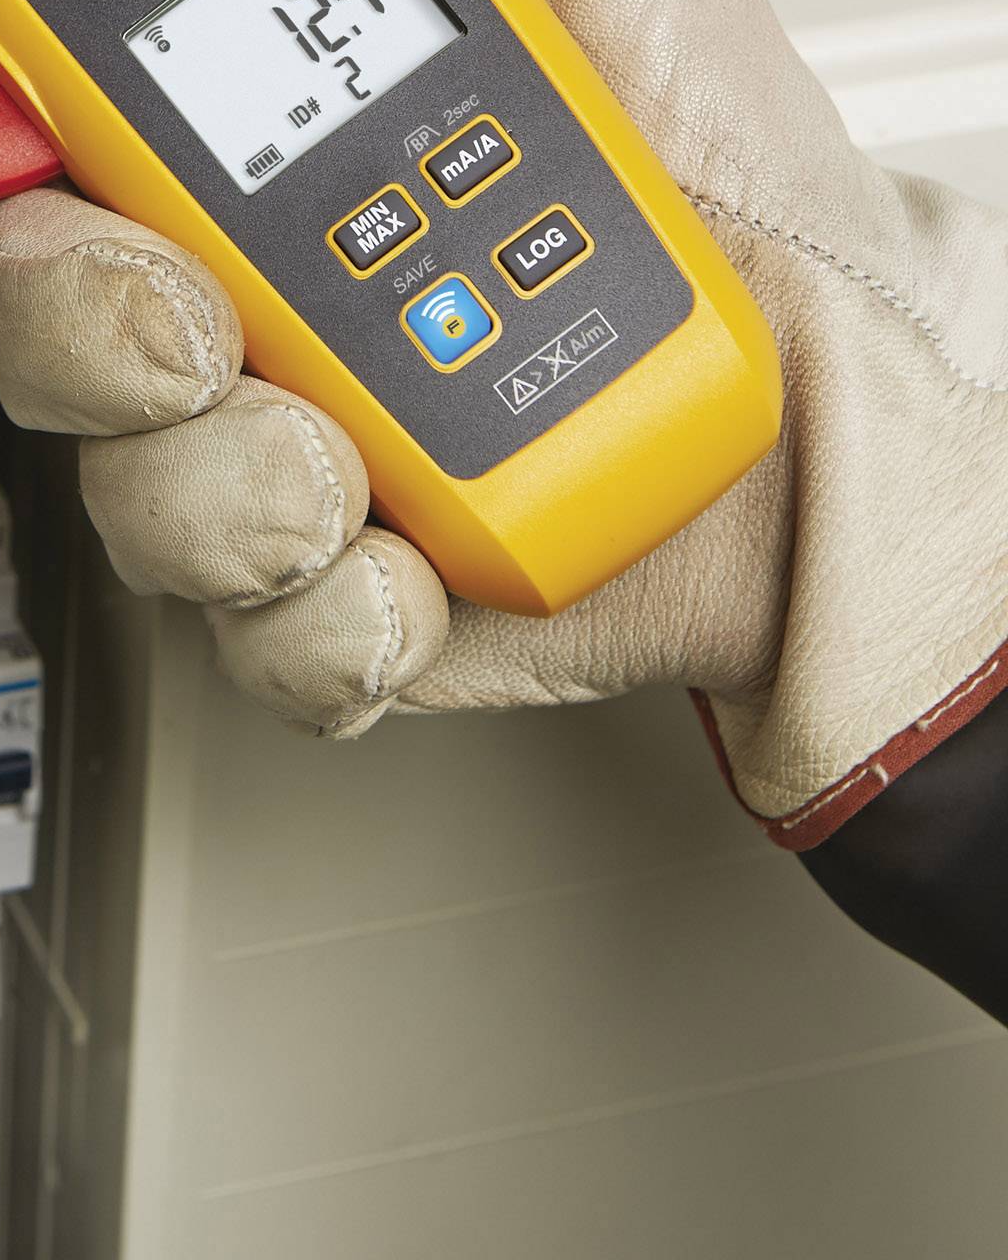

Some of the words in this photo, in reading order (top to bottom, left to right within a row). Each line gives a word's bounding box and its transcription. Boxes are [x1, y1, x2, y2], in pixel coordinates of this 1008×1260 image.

[287, 97, 322, 129] ID#
[334, 56, 371, 100] 2
[443, 94, 479, 126] 2sec
[441, 133, 499, 182] mA/A
[350, 200, 391, 236] MIN
[357, 212, 406, 255] MAX
[515, 227, 568, 270] LOG
[392, 255, 438, 295] SAVE
